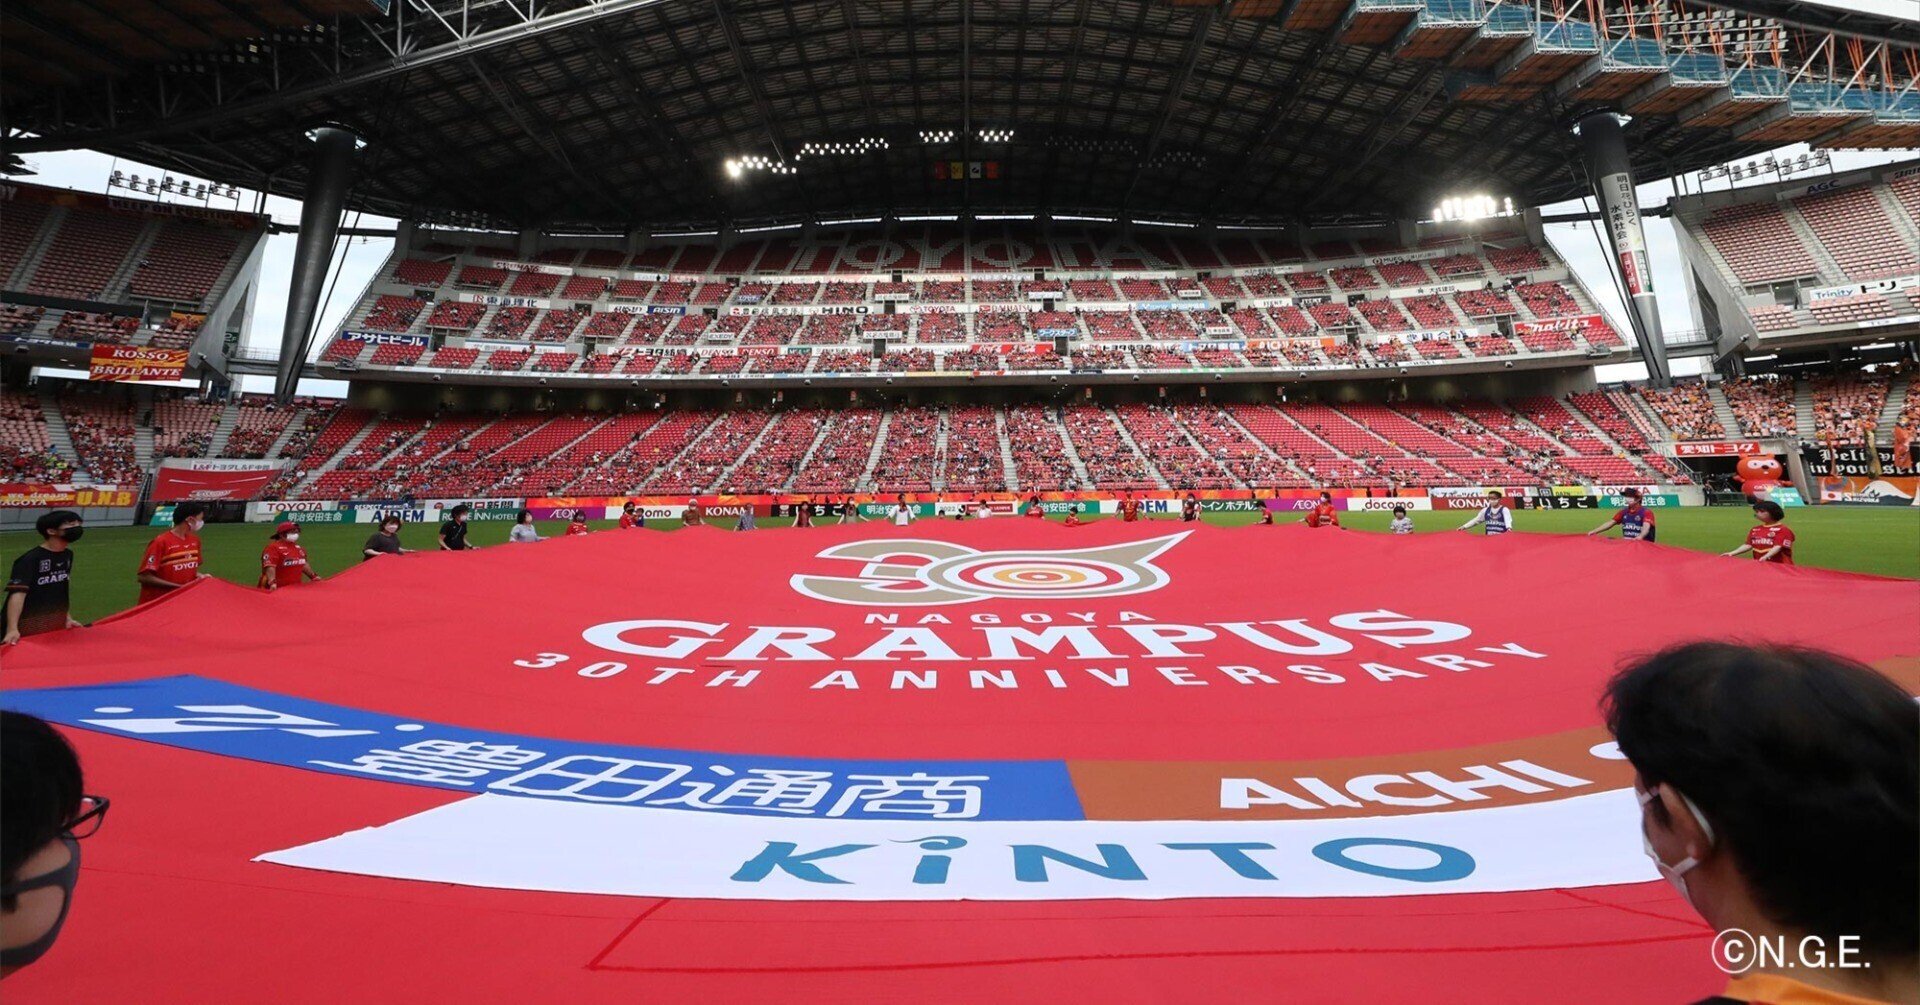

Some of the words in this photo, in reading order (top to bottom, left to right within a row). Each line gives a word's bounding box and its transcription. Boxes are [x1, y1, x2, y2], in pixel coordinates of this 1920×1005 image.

[1807, 180, 1840, 194] AGC
[1815, 289, 1853, 300] Trinity
[653, 307, 681, 315] AISIN
[822, 306, 868, 314] HINO
[923, 305, 955, 313] TOYOTA
[347, 332, 424, 347] アサヒビール
[700, 348, 734, 356] DENSO
[93, 365, 182, 377] BRILLANTE
[1681, 441, 1754, 454] 愛知トヨタ
[1810, 461, 1828, 473] in
[267, 502, 324, 512] TOYOTA
[1038, 502, 1086, 513] 治安田生命
[1365, 499, 1414, 510] docomo
[1448, 498, 1491, 509] KONAM
[287, 511, 343, 523] 明治安田生命
[864, 611, 1155, 625] NAGOYA
[582, 609, 1472, 662] GRAMPUS
[513, 652, 762, 688] 30TH
[810, 642, 1548, 689] ANNIVERSARY
[1219, 758, 1593, 810] AICHI
